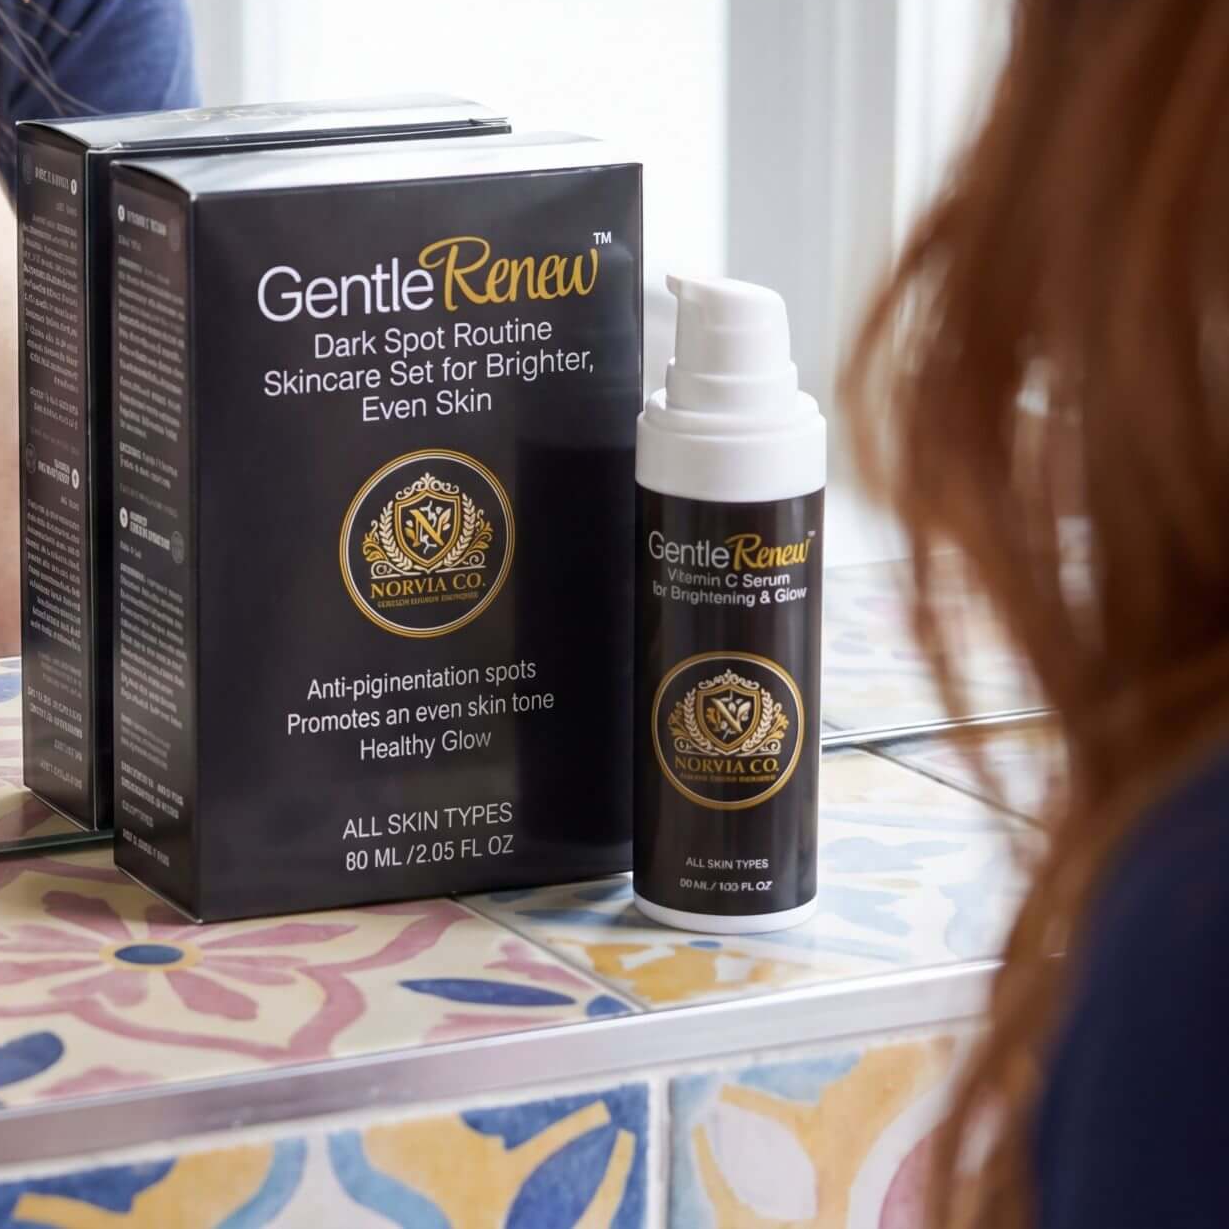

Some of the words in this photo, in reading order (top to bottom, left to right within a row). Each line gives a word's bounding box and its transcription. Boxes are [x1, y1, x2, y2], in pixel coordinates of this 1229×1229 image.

[258, 257, 434, 322] Gentle
[418, 235, 600, 312] Renew
[314, 331, 377, 359] Dark
[384, 325, 445, 359] Spot
[454, 318, 552, 348] Routine
[264, 365, 381, 396] Skincare
[389, 360, 434, 388] Set
[442, 357, 478, 382] for
[486, 348, 594, 382] Brighter,
[362, 394, 427, 422] Even
[436, 389, 492, 416] Skin
[648, 531, 730, 568] Gentle
[370, 576, 447, 599] NORVIA
[725, 573, 738, 588] C
[742, 573, 790, 588] Serum
[760, 590, 771, 604] &
[485, 660, 537, 687] spots
[287, 708, 380, 735] Promotes
[386, 707, 409, 725] an
[416, 702, 462, 722] even
[467, 695, 506, 717] skin
[512, 692, 554, 714] tone
[361, 733, 436, 760] Healthy
[441, 729, 491, 751] Glow
[674, 755, 744, 774] NORVIA
[342, 816, 383, 840] ALL
[388, 810, 438, 835] SKIN
[443, 802, 513, 828] TYPES
[375, 847, 402, 868] ML
[461, 838, 483, 858] FL
[488, 834, 514, 855] OZ
[685, 857, 705, 868] ALL
[707, 859, 733, 869] SKIN
[735, 858, 769, 869] TYPES
